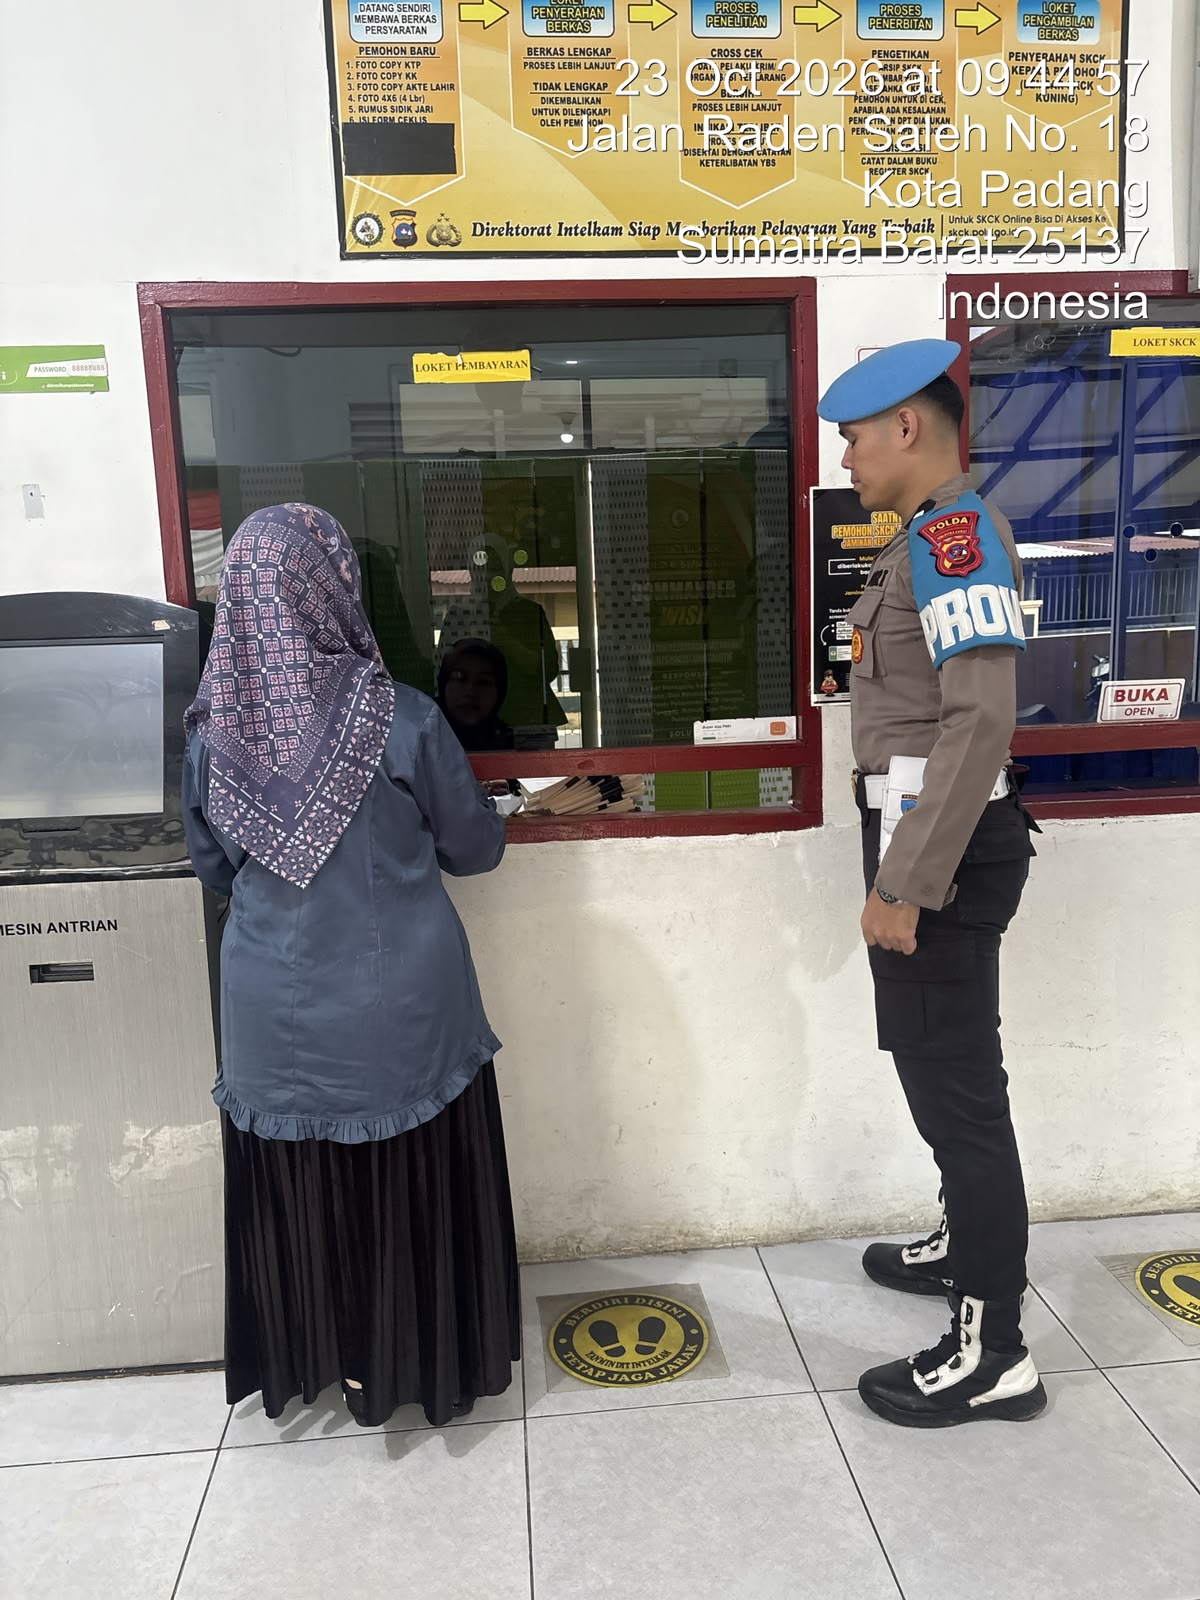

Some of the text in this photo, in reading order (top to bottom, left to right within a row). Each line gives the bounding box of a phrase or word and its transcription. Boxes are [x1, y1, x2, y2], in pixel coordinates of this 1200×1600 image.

[359, 4, 431, 12] DATANG SENDIRI
[715, 2, 758, 14] PROSES
[879, 4, 922, 17] PROSES
[1043, 2, 1076, 14] LOKET
[532, 7, 605, 19] PENYERAHAN
[354, 15, 437, 23] MEMBAWA BERKAS
[706, 15, 767, 27] PENELITIAN
[1023, 14, 1095, 28] PENGAMBILAN
[547, 20, 591, 33] BERKAS
[868, 18, 933, 30] PENERBITAN
[365, 26, 427, 34] PERSYARATAN
[1038, 28, 1079, 40] BERKAS
[359, 47, 436, 55] PEMOHON BARU
[527, 48, 612, 57] BERKAS LENGKAP
[711, 49, 763, 58] CROSS CEK
[871, 50, 929, 59] PENGETIKAN
[1009, 52, 1076, 63] PENYERAHAN
[346, 61, 421, 69] 1. FOTO COPY KTP
[523, 62, 616, 70] PROSES LEBIH LANJUT
[347, 72, 418, 80] 2. FOTO COPY KK
[348, 83, 455, 91] 3. FOTO COPY AKTE LAHIR
[533, 82, 608, 91] TIDAK LENGKAP
[348, 94, 355, 102] 4.
[358, 94, 379, 102] FOTO
[382, 94, 397, 102] 4X6
[541, 97, 601, 105] DIKEMBALIKAN
[854, 95, 891, 103] PEMOHON
[893, 95, 917, 103] UNTUK
[920, 95, 928, 103] DI
[349, 105, 434, 113] 5. RUMUS SIDIK JARI
[532, 108, 611, 116] UNTUK DILENGKAPI
[692, 104, 782, 112] PROSES LEBIH LANJUT
[853, 106, 946, 114] APABILA ADA KESALAHAN
[540, 119, 561, 127] OLEH
[914, 117, 951, 125] DIAUKAN
[699, 159, 776, 167] KETERLIBATAN YBS
[861, 157, 938, 165] CATAT DALAM BUKU
[949, 214, 1106, 224] Untuk SKCK Online Bisa Di Akses Ke
[471, 221, 552, 237] Direktorat
[557, 221, 624, 237] Intelkam
[628, 221, 661, 241] Siap
[842, 219, 878, 239] Yang
[1133, 337, 1197, 348] LOKET SKCK
[415, 359, 529, 373] LOKET PEMBAYARAN
[928, 516, 969, 534] POLDA
[833, 525, 873, 538] PEMOHON
[1113, 688, 1169, 703] BUKA
[1124, 707, 1155, 717] OPEN
[47, 919, 119, 934] ANTRIAN
[1145, 1255, 1198, 1280] BERDIRI
[565, 1296, 688, 1327] BERDIRI DISINI
[562, 1343, 699, 1382] TETAP JAGA JARAK
